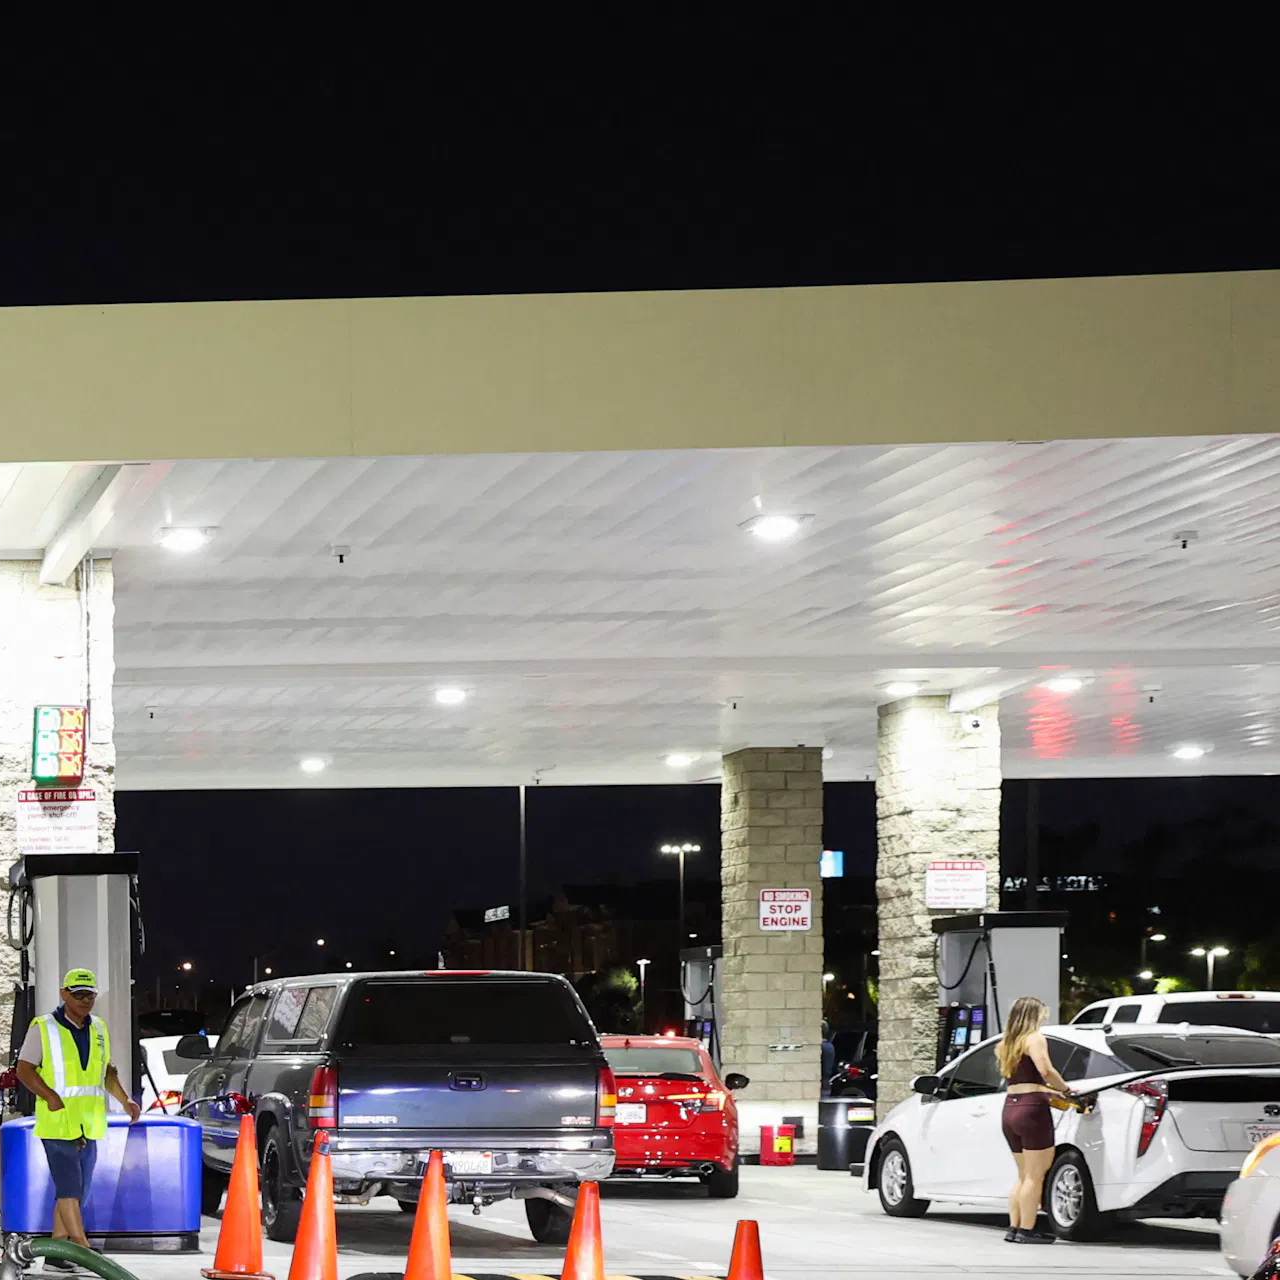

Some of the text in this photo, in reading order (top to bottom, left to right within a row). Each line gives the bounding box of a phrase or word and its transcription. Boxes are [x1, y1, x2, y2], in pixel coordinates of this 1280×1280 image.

[53, 791, 66, 800] FIRE
[769, 904, 802, 914] STOP
[762, 917, 808, 926] ENGINE
